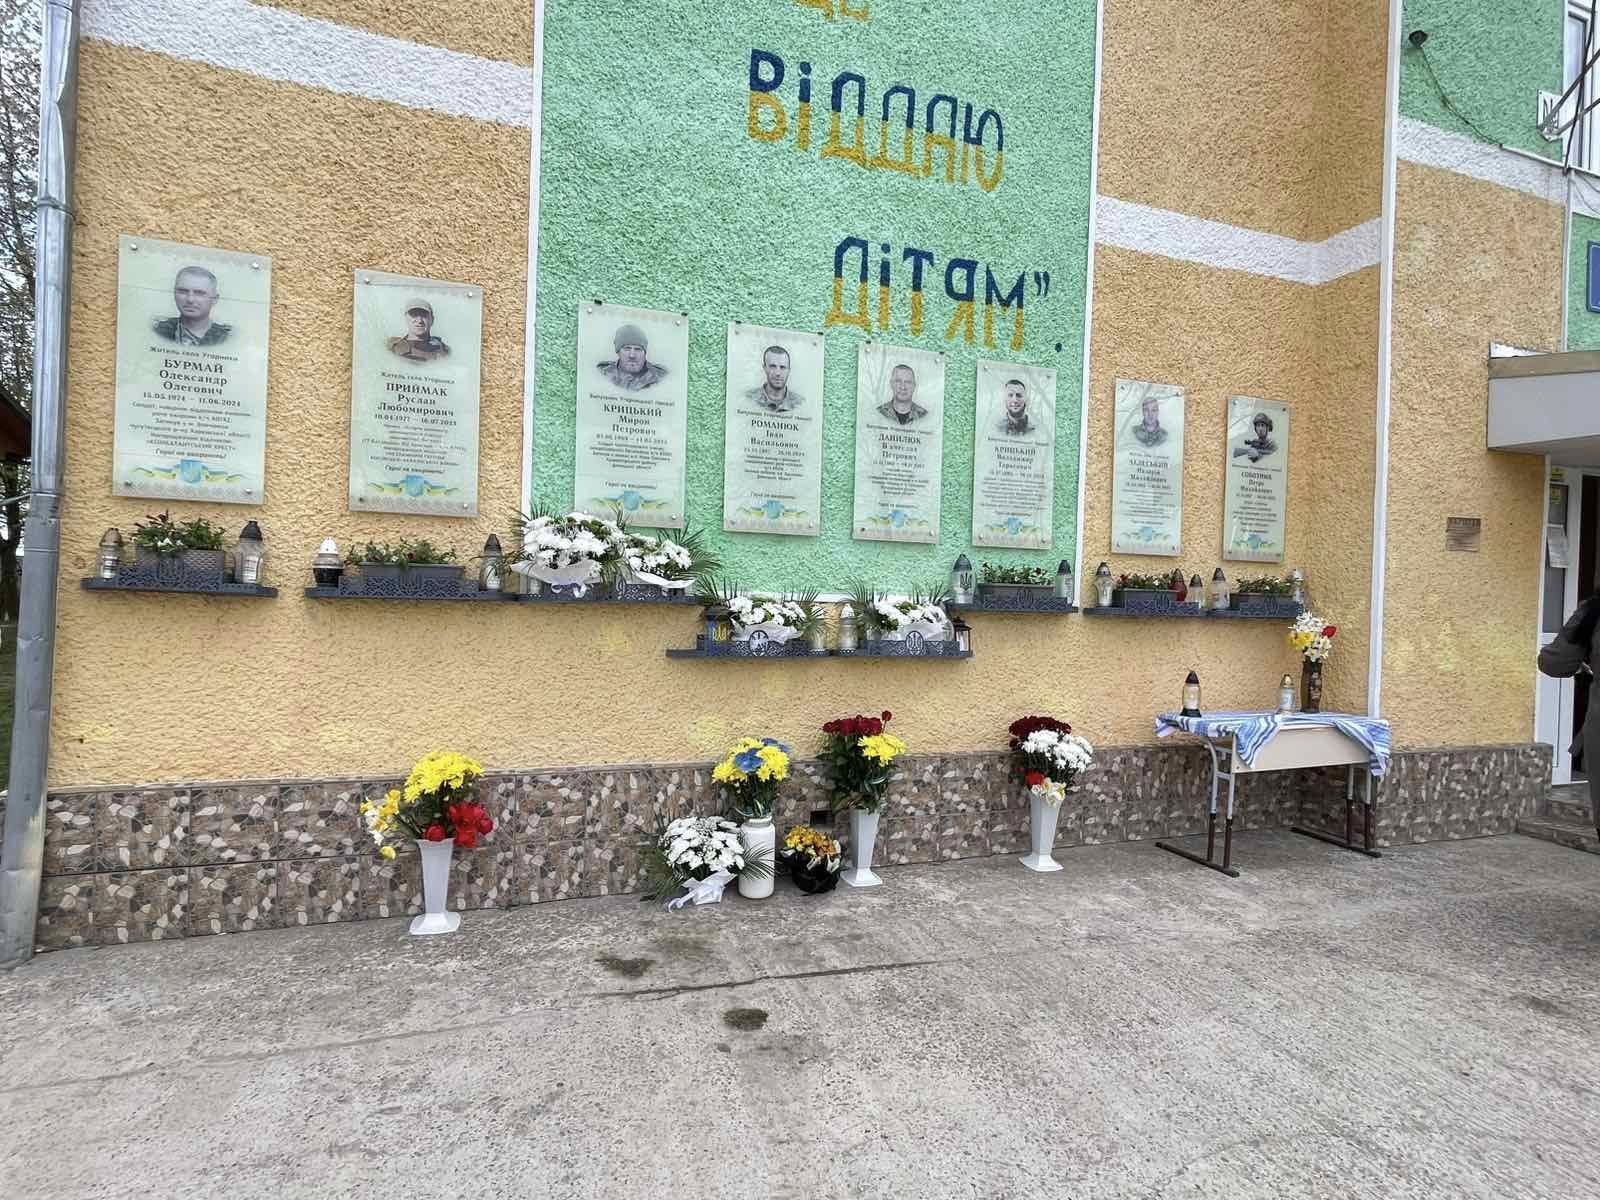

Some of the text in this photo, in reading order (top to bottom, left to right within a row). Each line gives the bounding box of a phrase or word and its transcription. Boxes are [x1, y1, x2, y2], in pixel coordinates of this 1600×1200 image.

[164, 359, 224, 374] БУРМАЙ
[159, 370, 227, 386] Олександр
[163, 381, 223, 395] Олегович
[386, 382, 448, 397] ПРИЙМАК
[398, 394, 436, 405] Руслан
[378, 402, 454, 416] Любомирович
[604, 404, 662, 416] КРИЦЬКИЙ
[619, 416, 650, 426] Мирон
[752, 420, 799, 432] РОМАНЮК
[612, 424, 656, 436] Петрович
[766, 430, 784, 439] Іван
[751, 437, 799, 449] Васильович
[878, 433, 921, 444] ДАНИЛЮК
